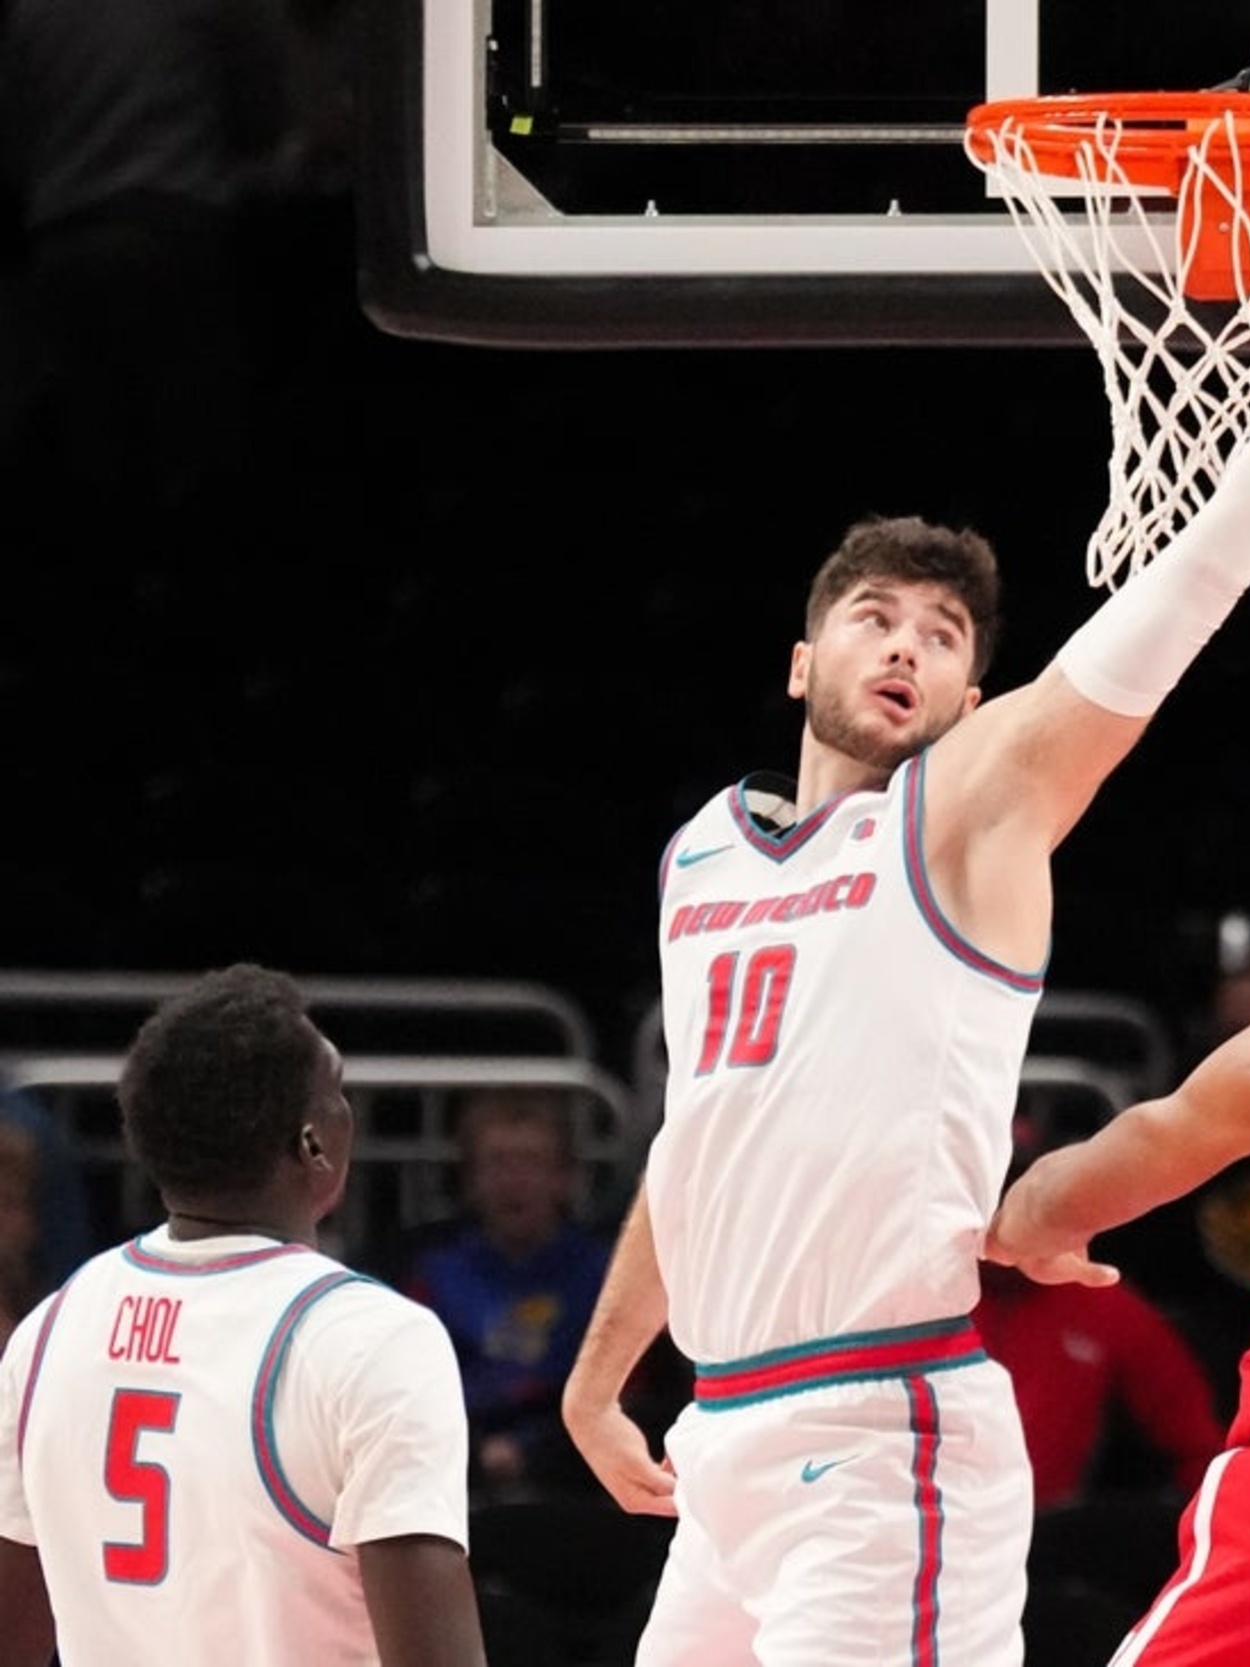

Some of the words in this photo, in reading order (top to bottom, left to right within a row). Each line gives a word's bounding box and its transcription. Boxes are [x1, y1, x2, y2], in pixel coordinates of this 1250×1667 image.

[668, 900, 748, 943] NEW
[739, 872, 877, 927] MEXICO
[694, 943, 797, 1078] 10
[108, 1296, 182, 1363] CHOL
[102, 1387, 182, 1587] 5
